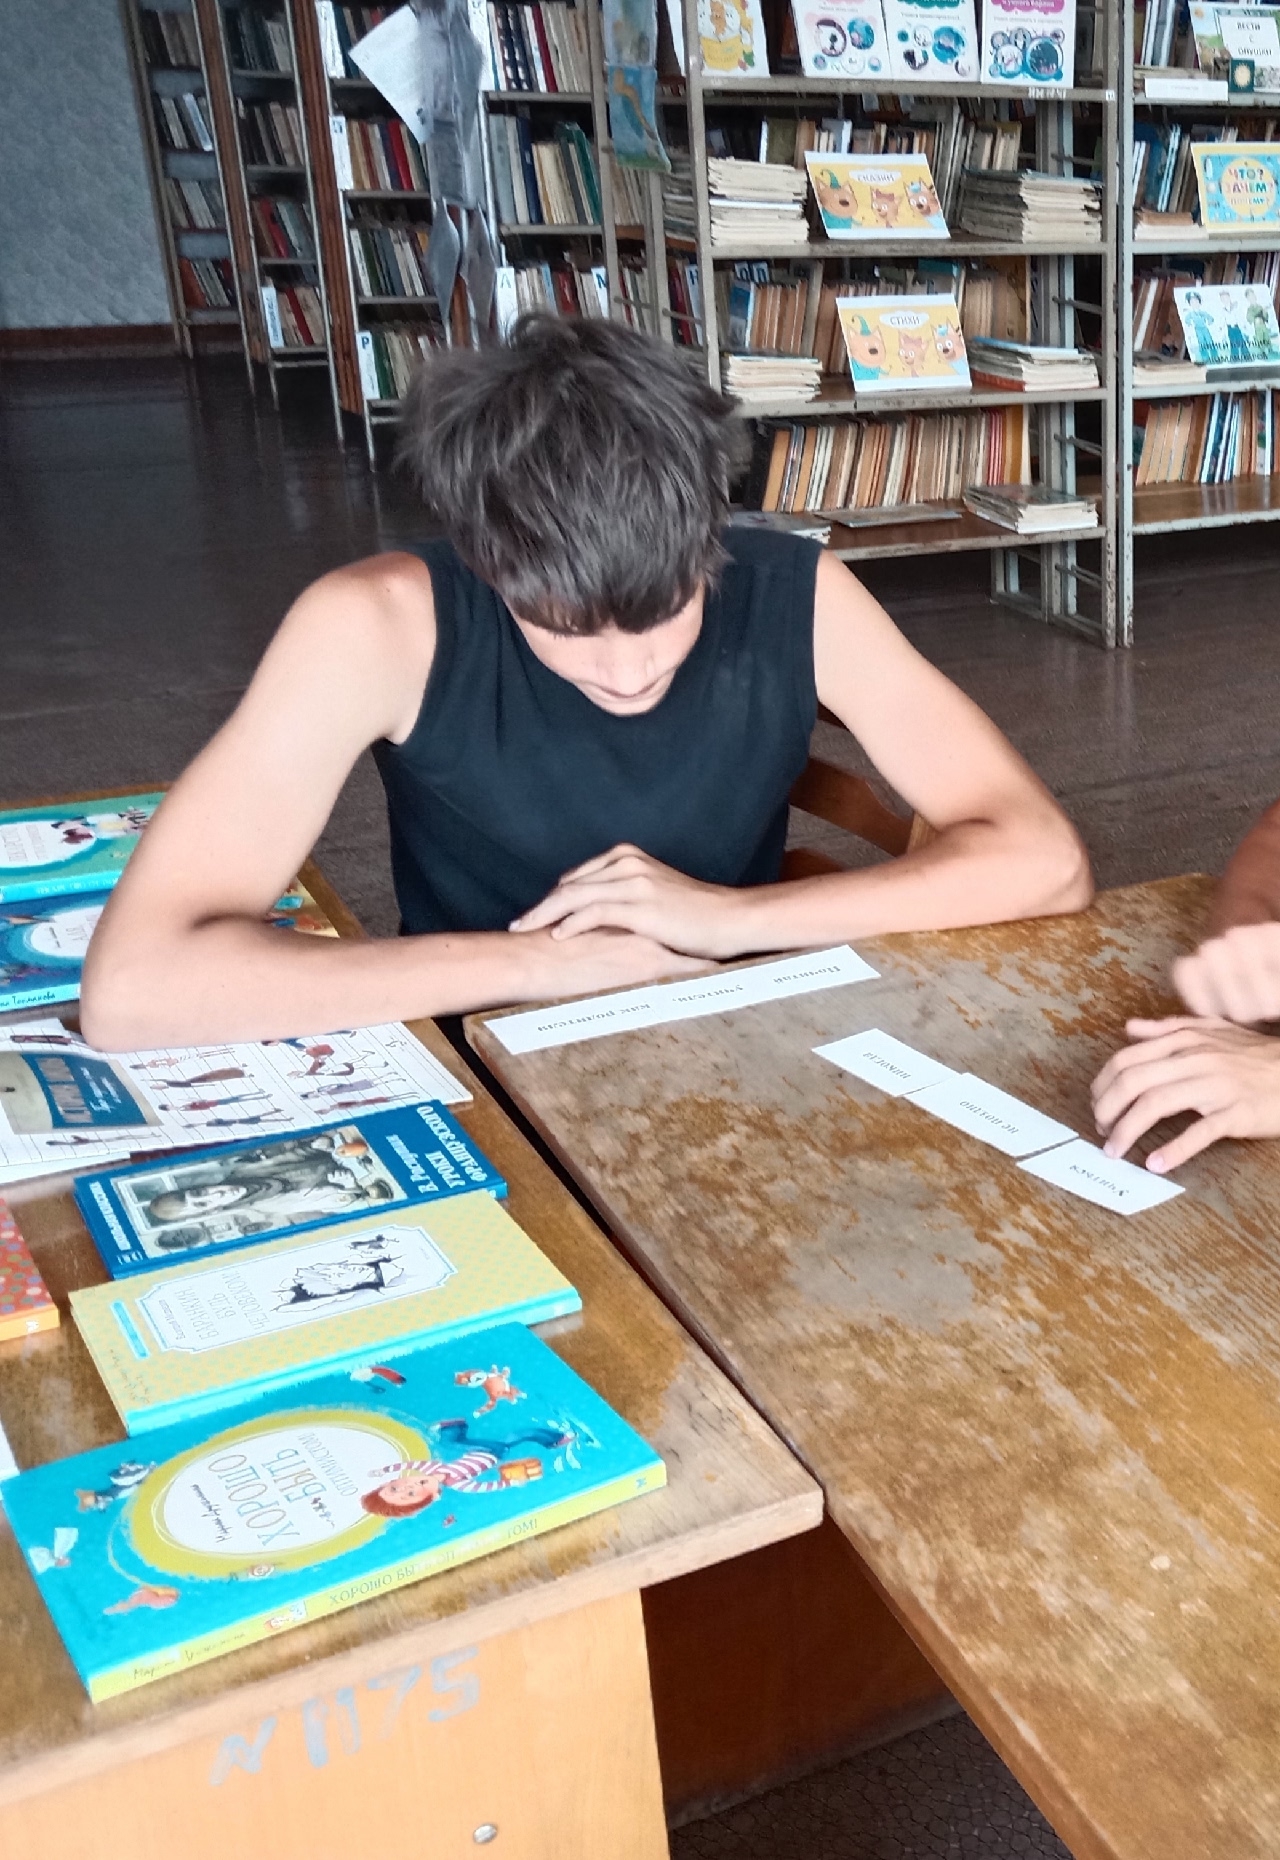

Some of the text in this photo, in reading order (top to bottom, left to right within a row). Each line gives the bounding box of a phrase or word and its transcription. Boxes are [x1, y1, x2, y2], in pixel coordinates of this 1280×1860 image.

[889, 315, 920, 326] СТИХИ
[772, 965, 841, 984] Почитай
[537, 1010, 616, 1032] родителя
[619, 1003, 651, 1015] как
[862, 1052, 912, 1080] никогда
[959, 1100, 1020, 1134] не поздно
[416, 1104, 488, 1182] ФРАНЦУЗСКОГО
[424, 1150, 466, 1189] УРОКИ
[1069, 1163, 1131, 1197] Учиться
[207, 1292, 237, 1320] БУДЬ
[260, 1447, 328, 1504] БЫТЬ
[207, 1454, 301, 1547] ХОРОШО
[328, 1573, 393, 1606] ХОРОШО
